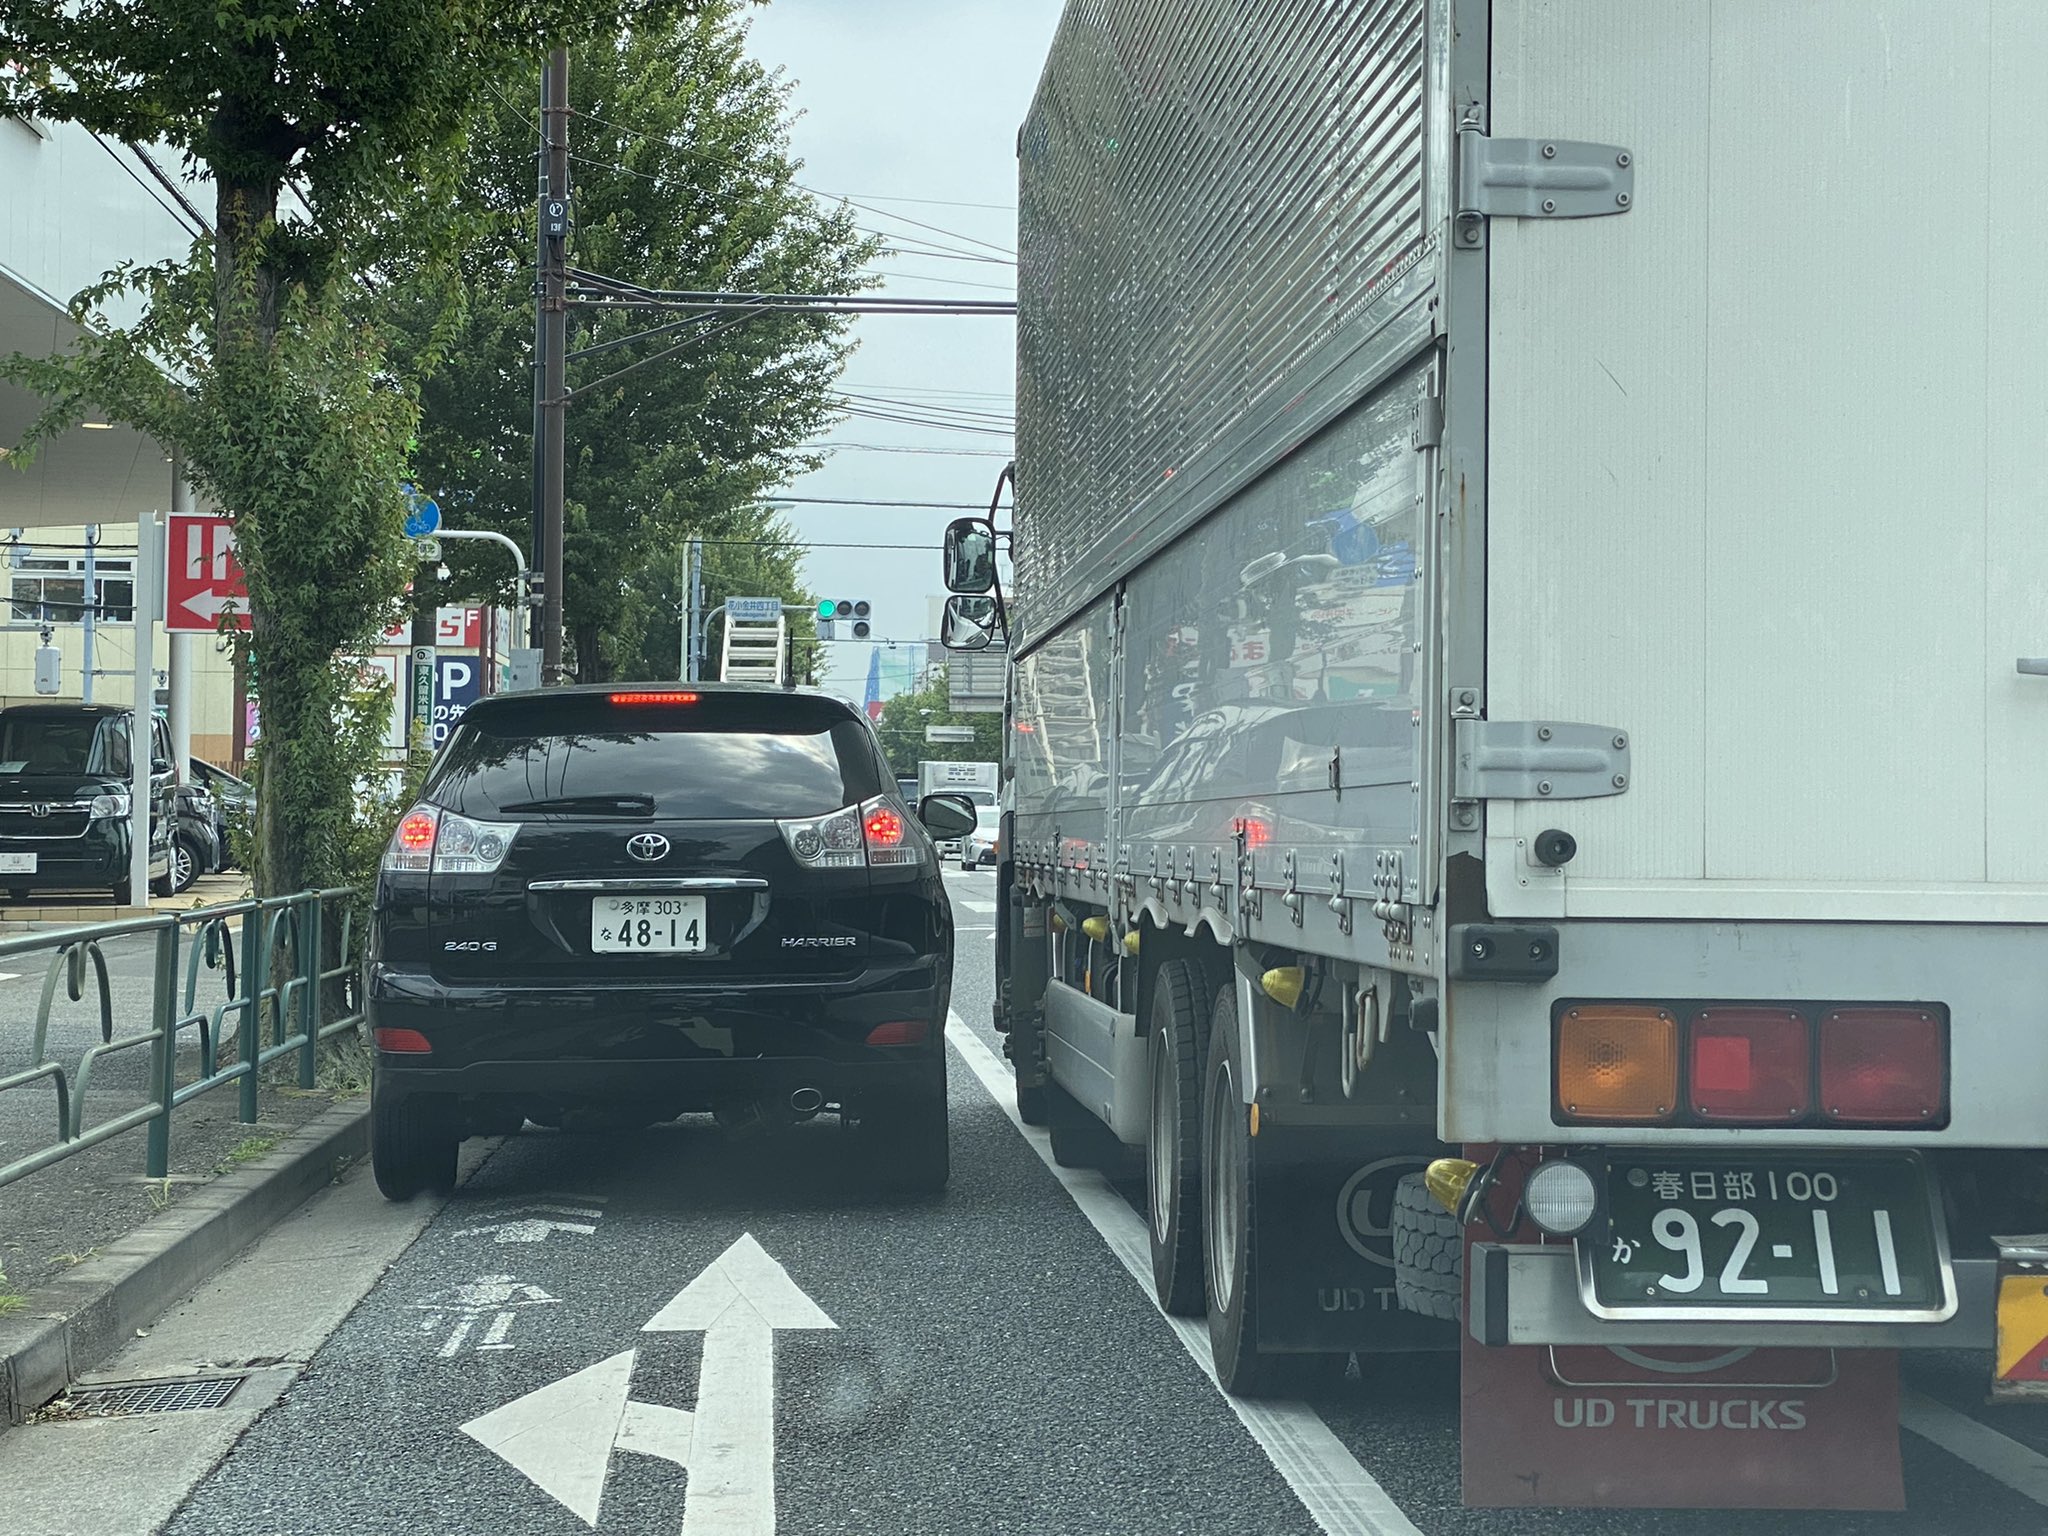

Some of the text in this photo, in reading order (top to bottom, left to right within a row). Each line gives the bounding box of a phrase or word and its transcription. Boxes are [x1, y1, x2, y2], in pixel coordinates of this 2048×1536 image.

[728, 600, 779, 611] 花小金井四丁目
[442, 662, 471, 700] P
[621, 900, 682, 915] 多摩 303
[601, 919, 699, 948] な 48-14
[781, 936, 856, 947] HARRIER
[1652, 1170, 1838, 1201] 春日部 100
[1612, 1208, 1902, 1296] か 92-11
[1553, 1398, 1807, 1430] UD TRUCKS
